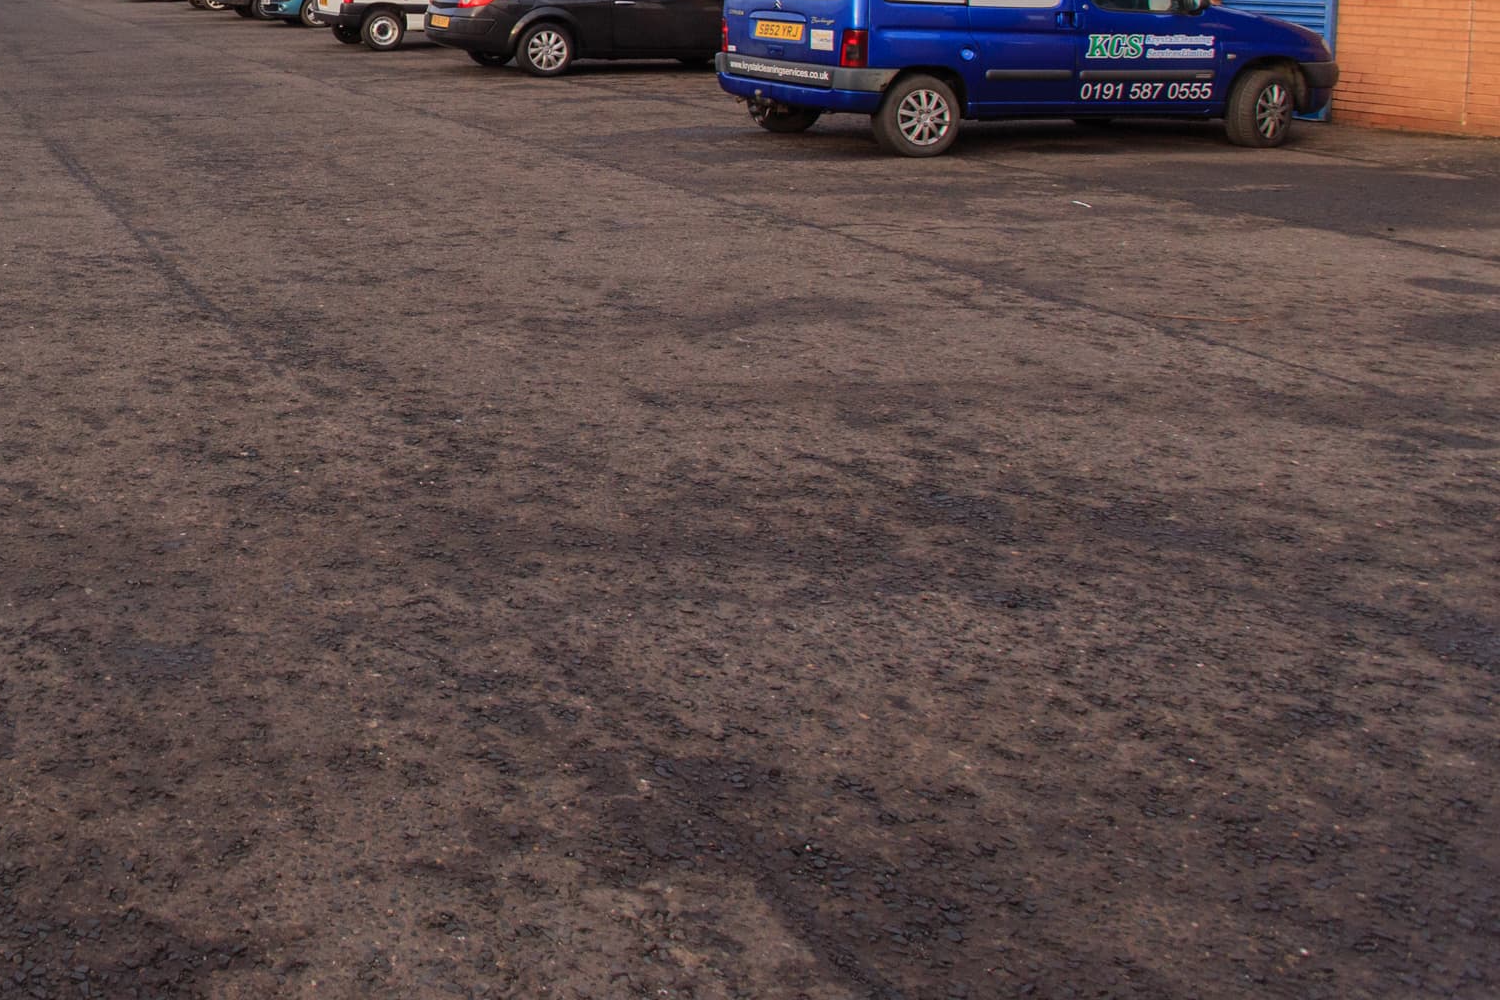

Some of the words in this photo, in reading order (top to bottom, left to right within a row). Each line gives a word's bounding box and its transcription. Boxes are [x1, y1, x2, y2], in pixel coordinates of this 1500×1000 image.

[759, 23, 781, 36] SB52
[781, 26, 799, 38] YRJ
[1085, 34, 1145, 59] KCS
[1080, 82, 1124, 100] 0191
[1129, 82, 1164, 100] 587
[1167, 82, 1213, 100] 0555
